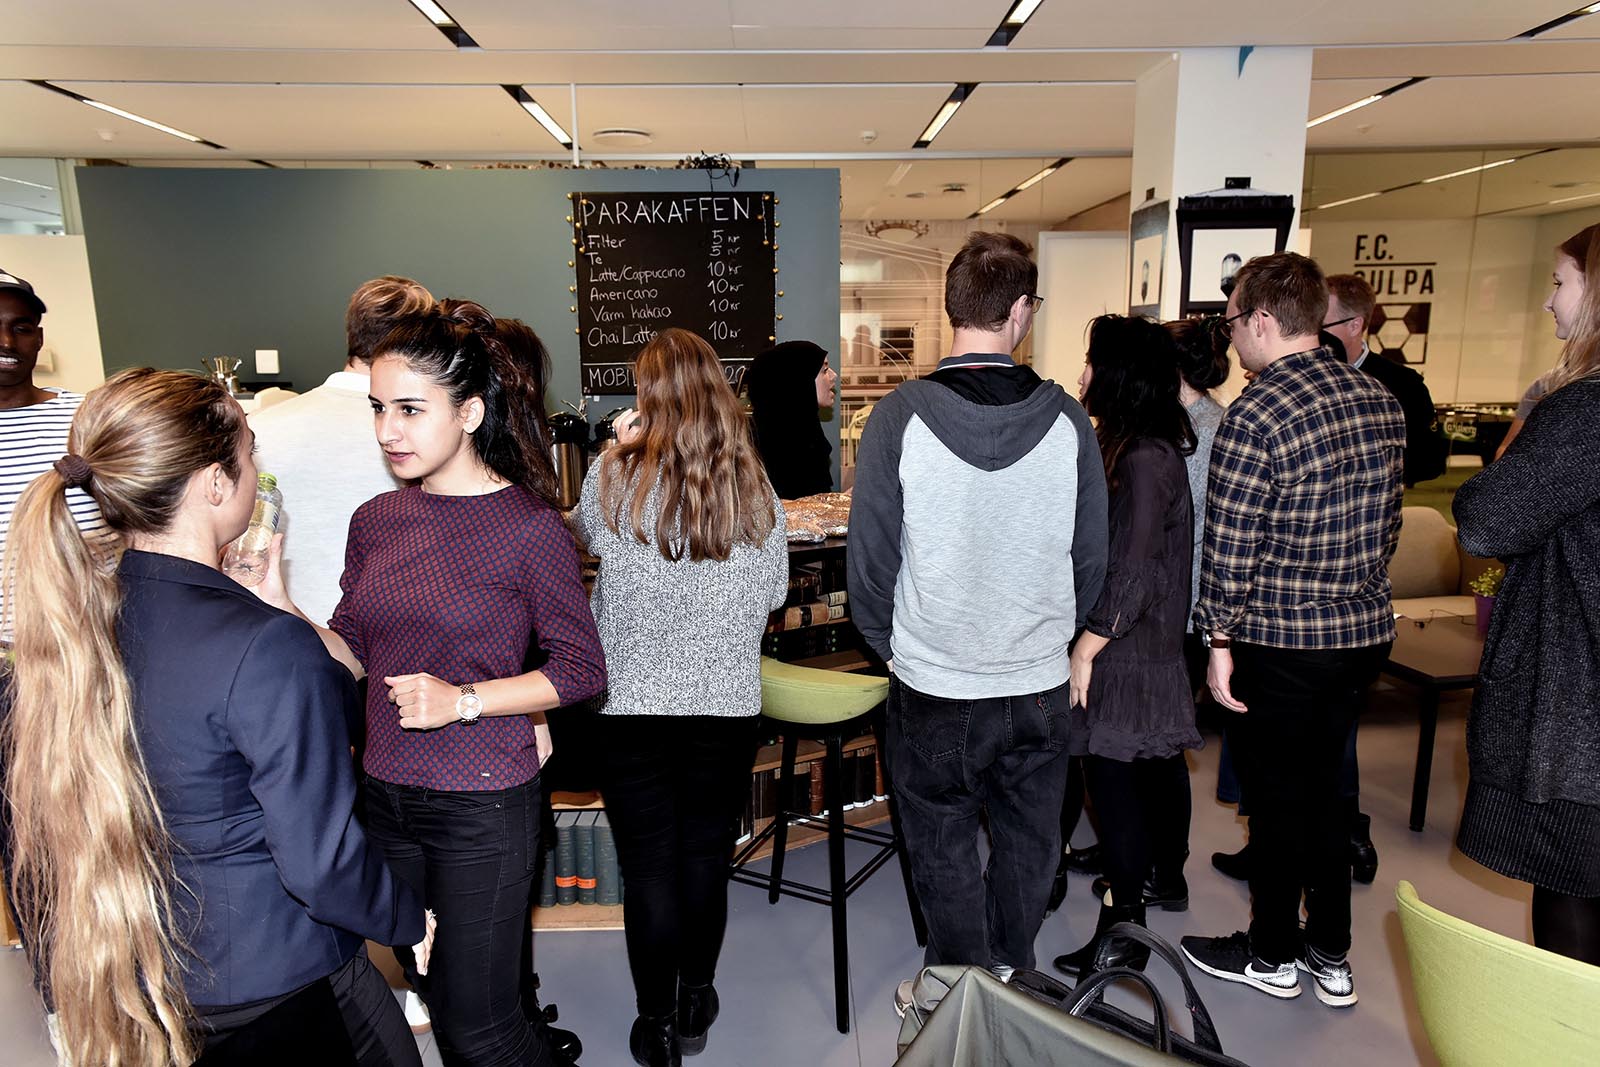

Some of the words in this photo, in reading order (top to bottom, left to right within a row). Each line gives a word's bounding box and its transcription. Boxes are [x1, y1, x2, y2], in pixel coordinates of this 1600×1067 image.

[582, 197, 750, 226] PARAKAFFEN
[587, 234, 626, 249] Filter
[711, 229, 724, 245] 5
[1355, 234, 1394, 260] F.C.
[585, 251, 603, 266] Te
[709, 245, 722, 256] 5
[707, 260, 725, 277] 10
[590, 286, 658, 302] Americano
[707, 278, 729, 294] 10
[1354, 269, 1434, 295] ULPA
[590, 305, 625, 322] Varm
[630, 303, 672, 319] kakao
[709, 298, 729, 313] 10
[587, 327, 620, 347] Chai
[622, 325, 659, 345] Latte
[708, 320, 728, 341] 10
